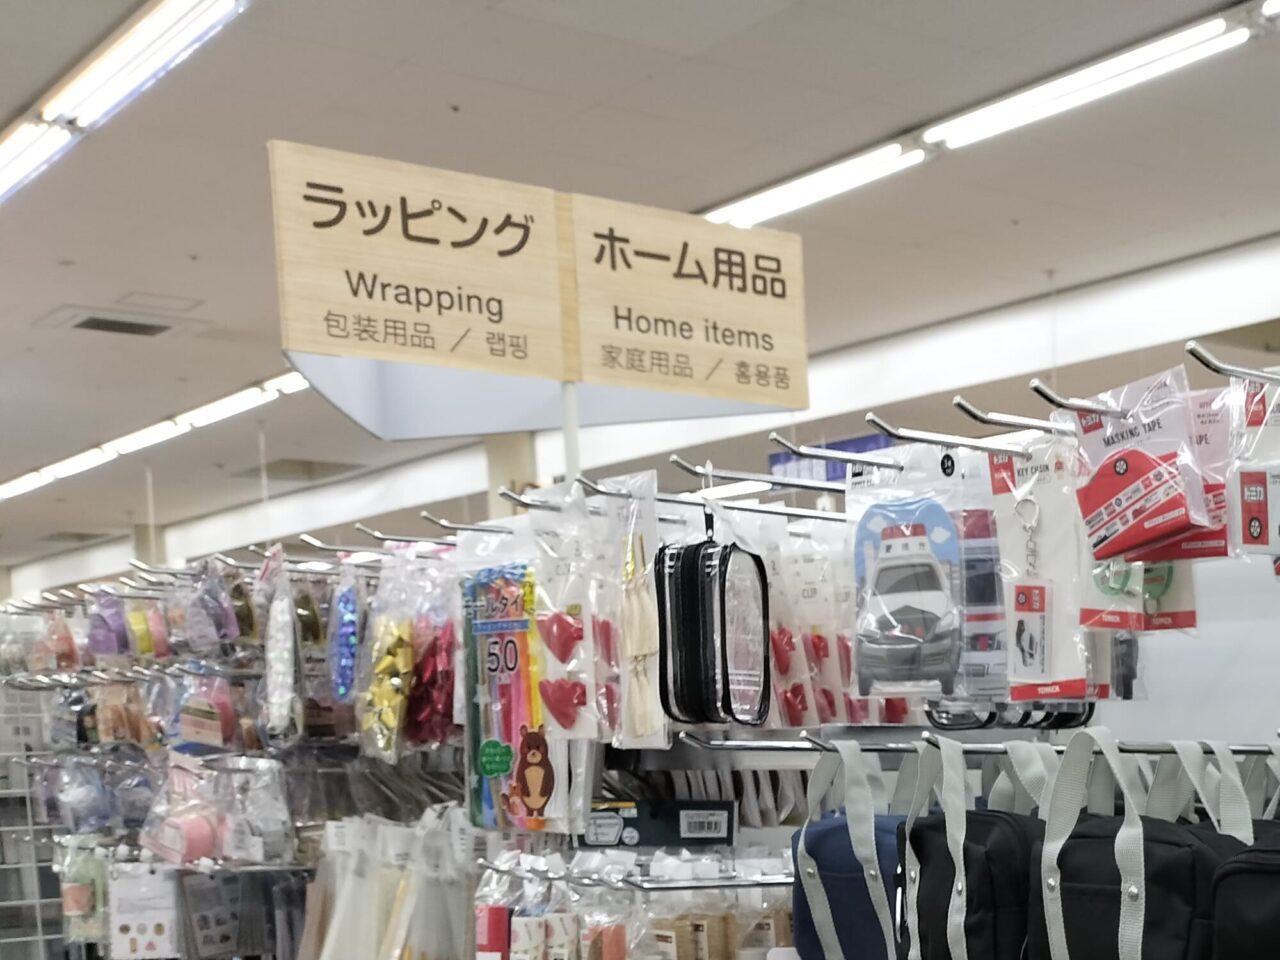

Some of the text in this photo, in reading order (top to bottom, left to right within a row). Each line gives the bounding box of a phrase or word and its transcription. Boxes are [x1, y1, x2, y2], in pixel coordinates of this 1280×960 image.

[303, 181, 535, 257] ラッピング
[593, 227, 787, 298] ホーム用品
[344, 269, 504, 323] Wrapping
[322, 310, 436, 350] 包装用品
[614, 306, 775, 352] Home items
[600, 343, 693, 379] 家庭用品
[1103, 418, 1163, 448] MASKING TAPE
[487, 638, 519, 673] 50
